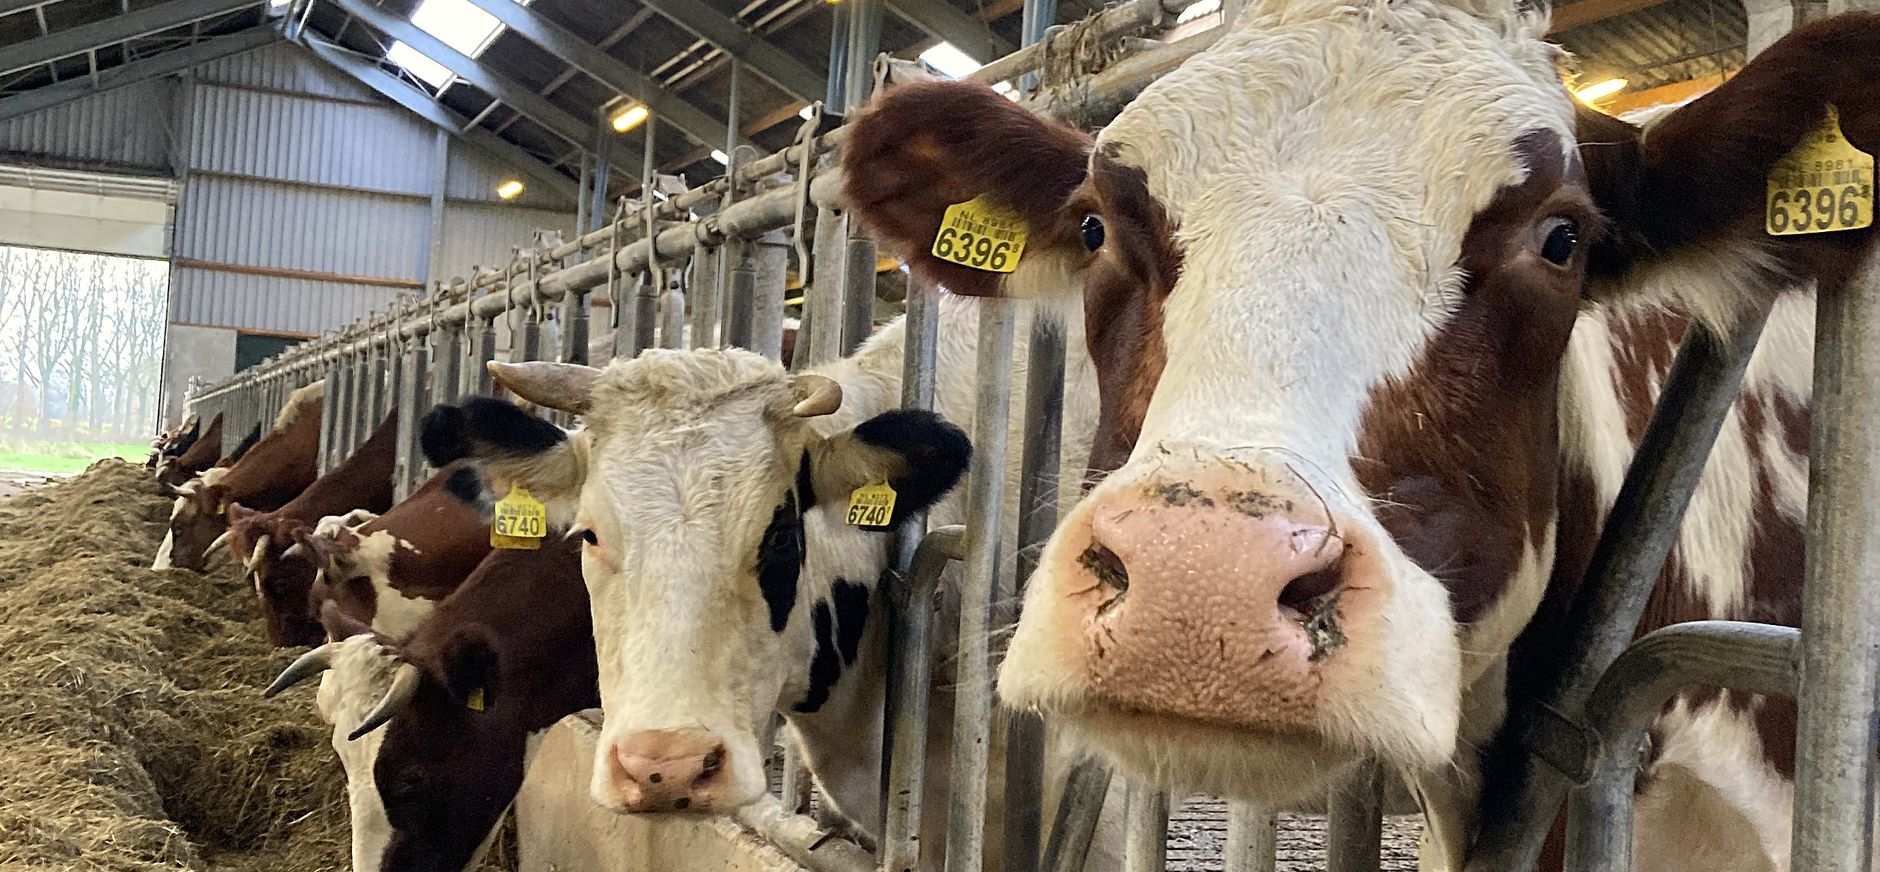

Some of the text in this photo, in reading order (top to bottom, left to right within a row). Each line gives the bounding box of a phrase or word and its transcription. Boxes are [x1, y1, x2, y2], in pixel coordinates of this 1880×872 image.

[1769, 185, 1858, 234] 6396
[936, 227, 1011, 270] 6396
[496, 514, 539, 536] 6740
[849, 505, 886, 525] 6740
